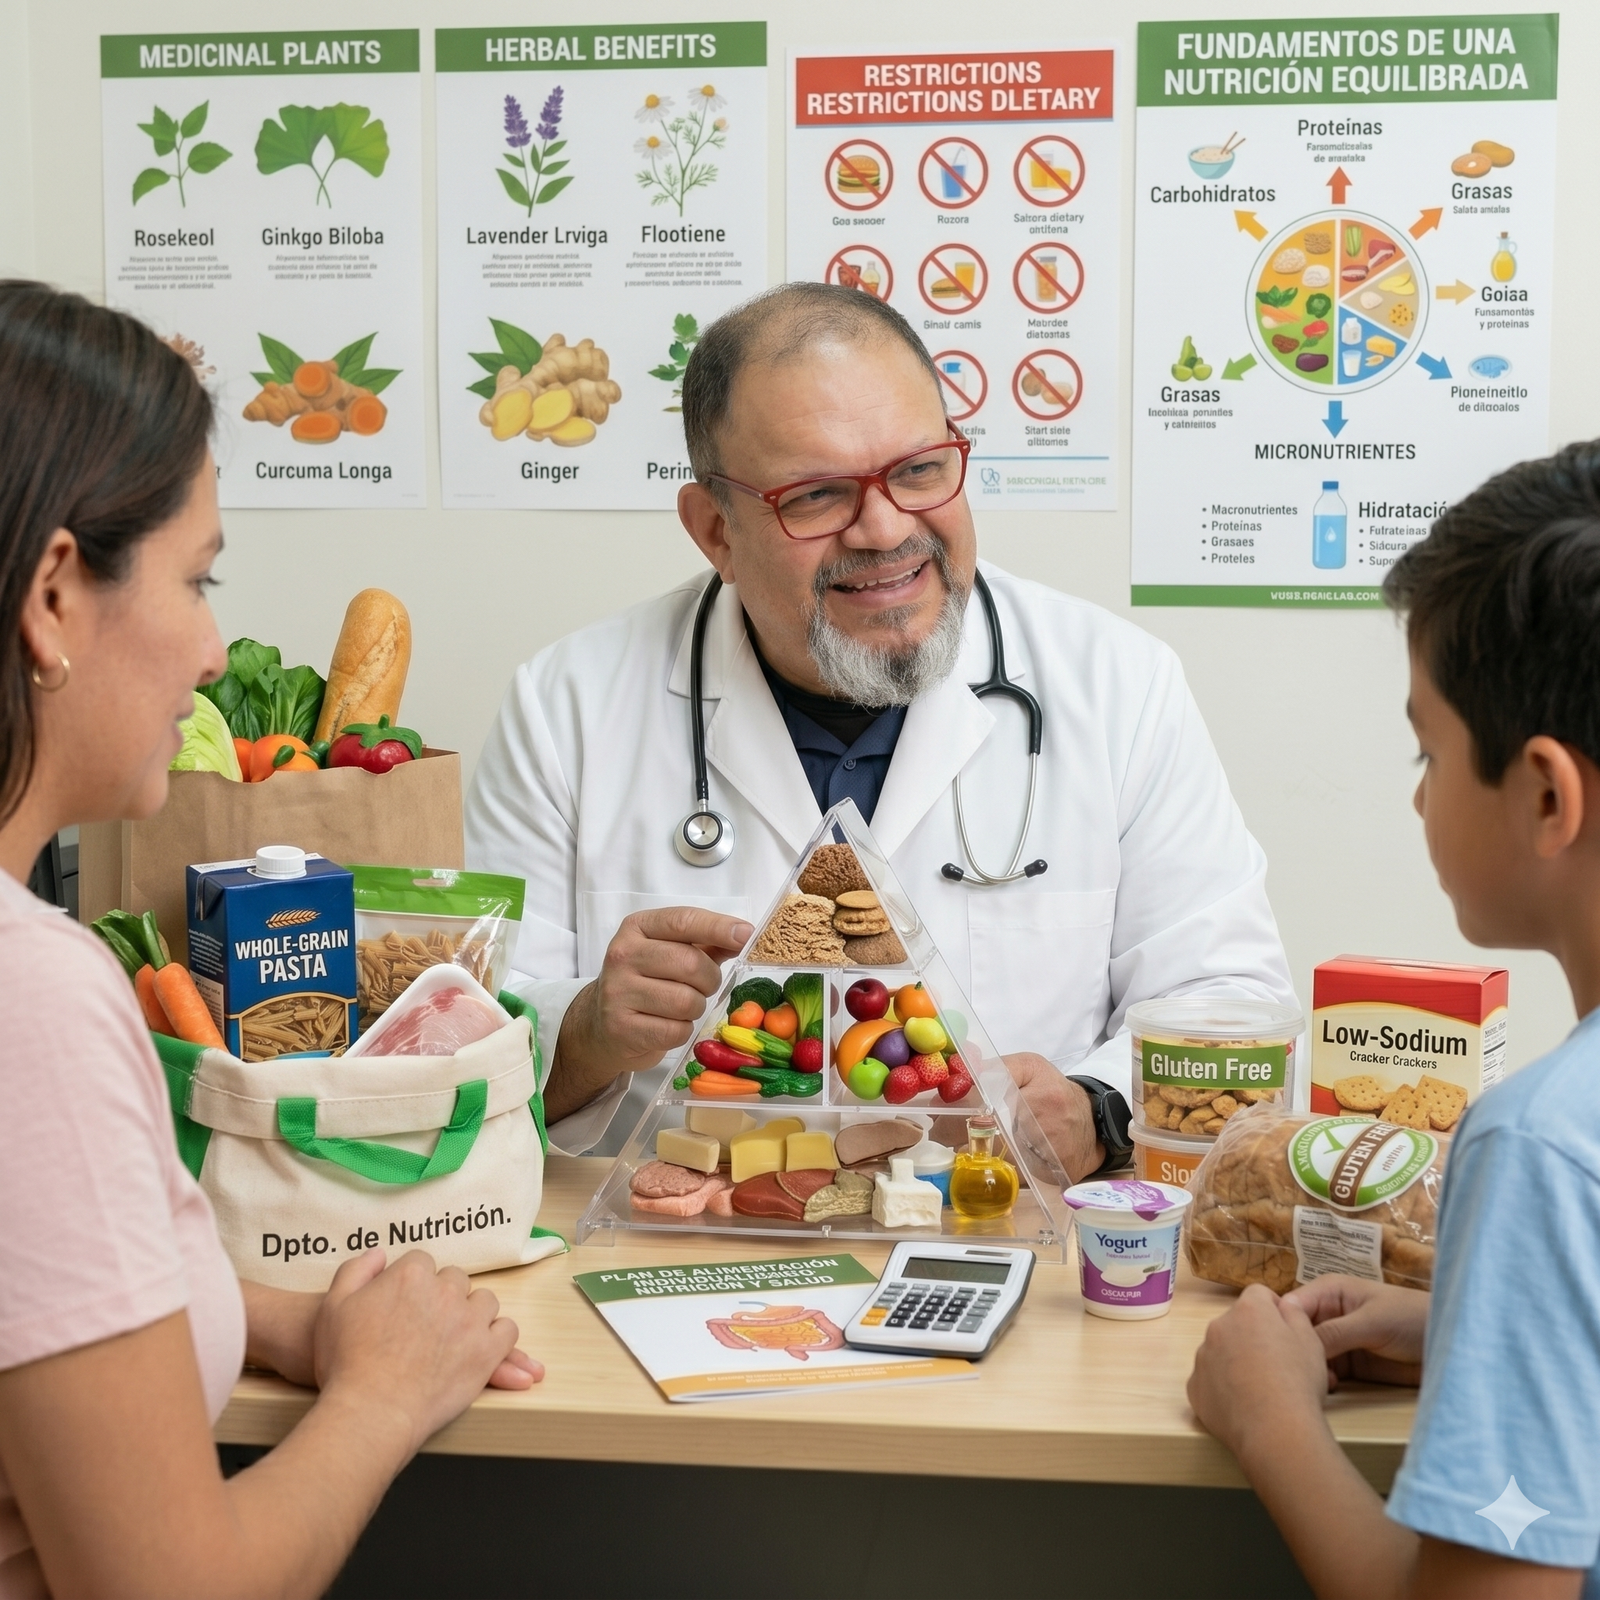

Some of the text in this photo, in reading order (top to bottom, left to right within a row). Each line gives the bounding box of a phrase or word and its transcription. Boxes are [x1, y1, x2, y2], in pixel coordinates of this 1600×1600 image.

[486, 34, 717, 62] HERBAL BENEFITS
[1177, 27, 1516, 60] FUNDAMENTOS DE UNA
[140, 40, 381, 68] MEDICINAL PLANTS
[865, 61, 1042, 87] RESTRICTIONS
[1164, 60, 1529, 95] NUTRICIÓN EQUILIBRADA
[807, 87, 1101, 115] RESTRICTIONS DLETARY
[1298, 118, 1382, 136] Proteínas
[1150, 184, 1276, 203] Carbohidratos
[1452, 182, 1512, 200] Grasas
[1050, 213, 1084, 224] dietary
[134, 228, 215, 247] Rosekeol
[262, 227, 384, 249] Ginkgo Biloba
[467, 225, 608, 248] Lavender Lrviga
[641, 224, 726, 243] Flootiene
[1479, 321, 1485, 330] y
[1161, 386, 1221, 402] Grasas
[1458, 402, 1471, 411] de
[1164, 422, 1169, 430] y
[1254, 444, 1416, 460] MICRONUTRIENTES
[256, 461, 392, 483] Curcuma Longa
[521, 462, 579, 483] Ginger
[647, 462, 693, 480] Perin
[1211, 504, 1298, 515] Macronutrientes
[1359, 501, 1447, 518] Hidratació
[1211, 536, 1254, 547] Grasaes
[1369, 556, 1395, 567] Supo
[235, 929, 349, 960] WHOLE-GRAIN
[260, 953, 327, 984] PASTA
[1323, 1019, 1467, 1056] Low-Sodium
[1151, 1053, 1218, 1080] Gluten
[1225, 1058, 1272, 1081] Free
[1350, 1050, 1437, 1069] Cracker Crackers
[1334, 1140, 1376, 1199] GLUTEN
[262, 1204, 512, 1262] Dpto. de Nutrición.
[1095, 1232, 1147, 1254] Yogurt
[599, 1271, 654, 1283] PLAN
[658, 1269, 685, 1278] DE
[634, 1275, 834, 1296] NUTRICIÓN Y SALUD
